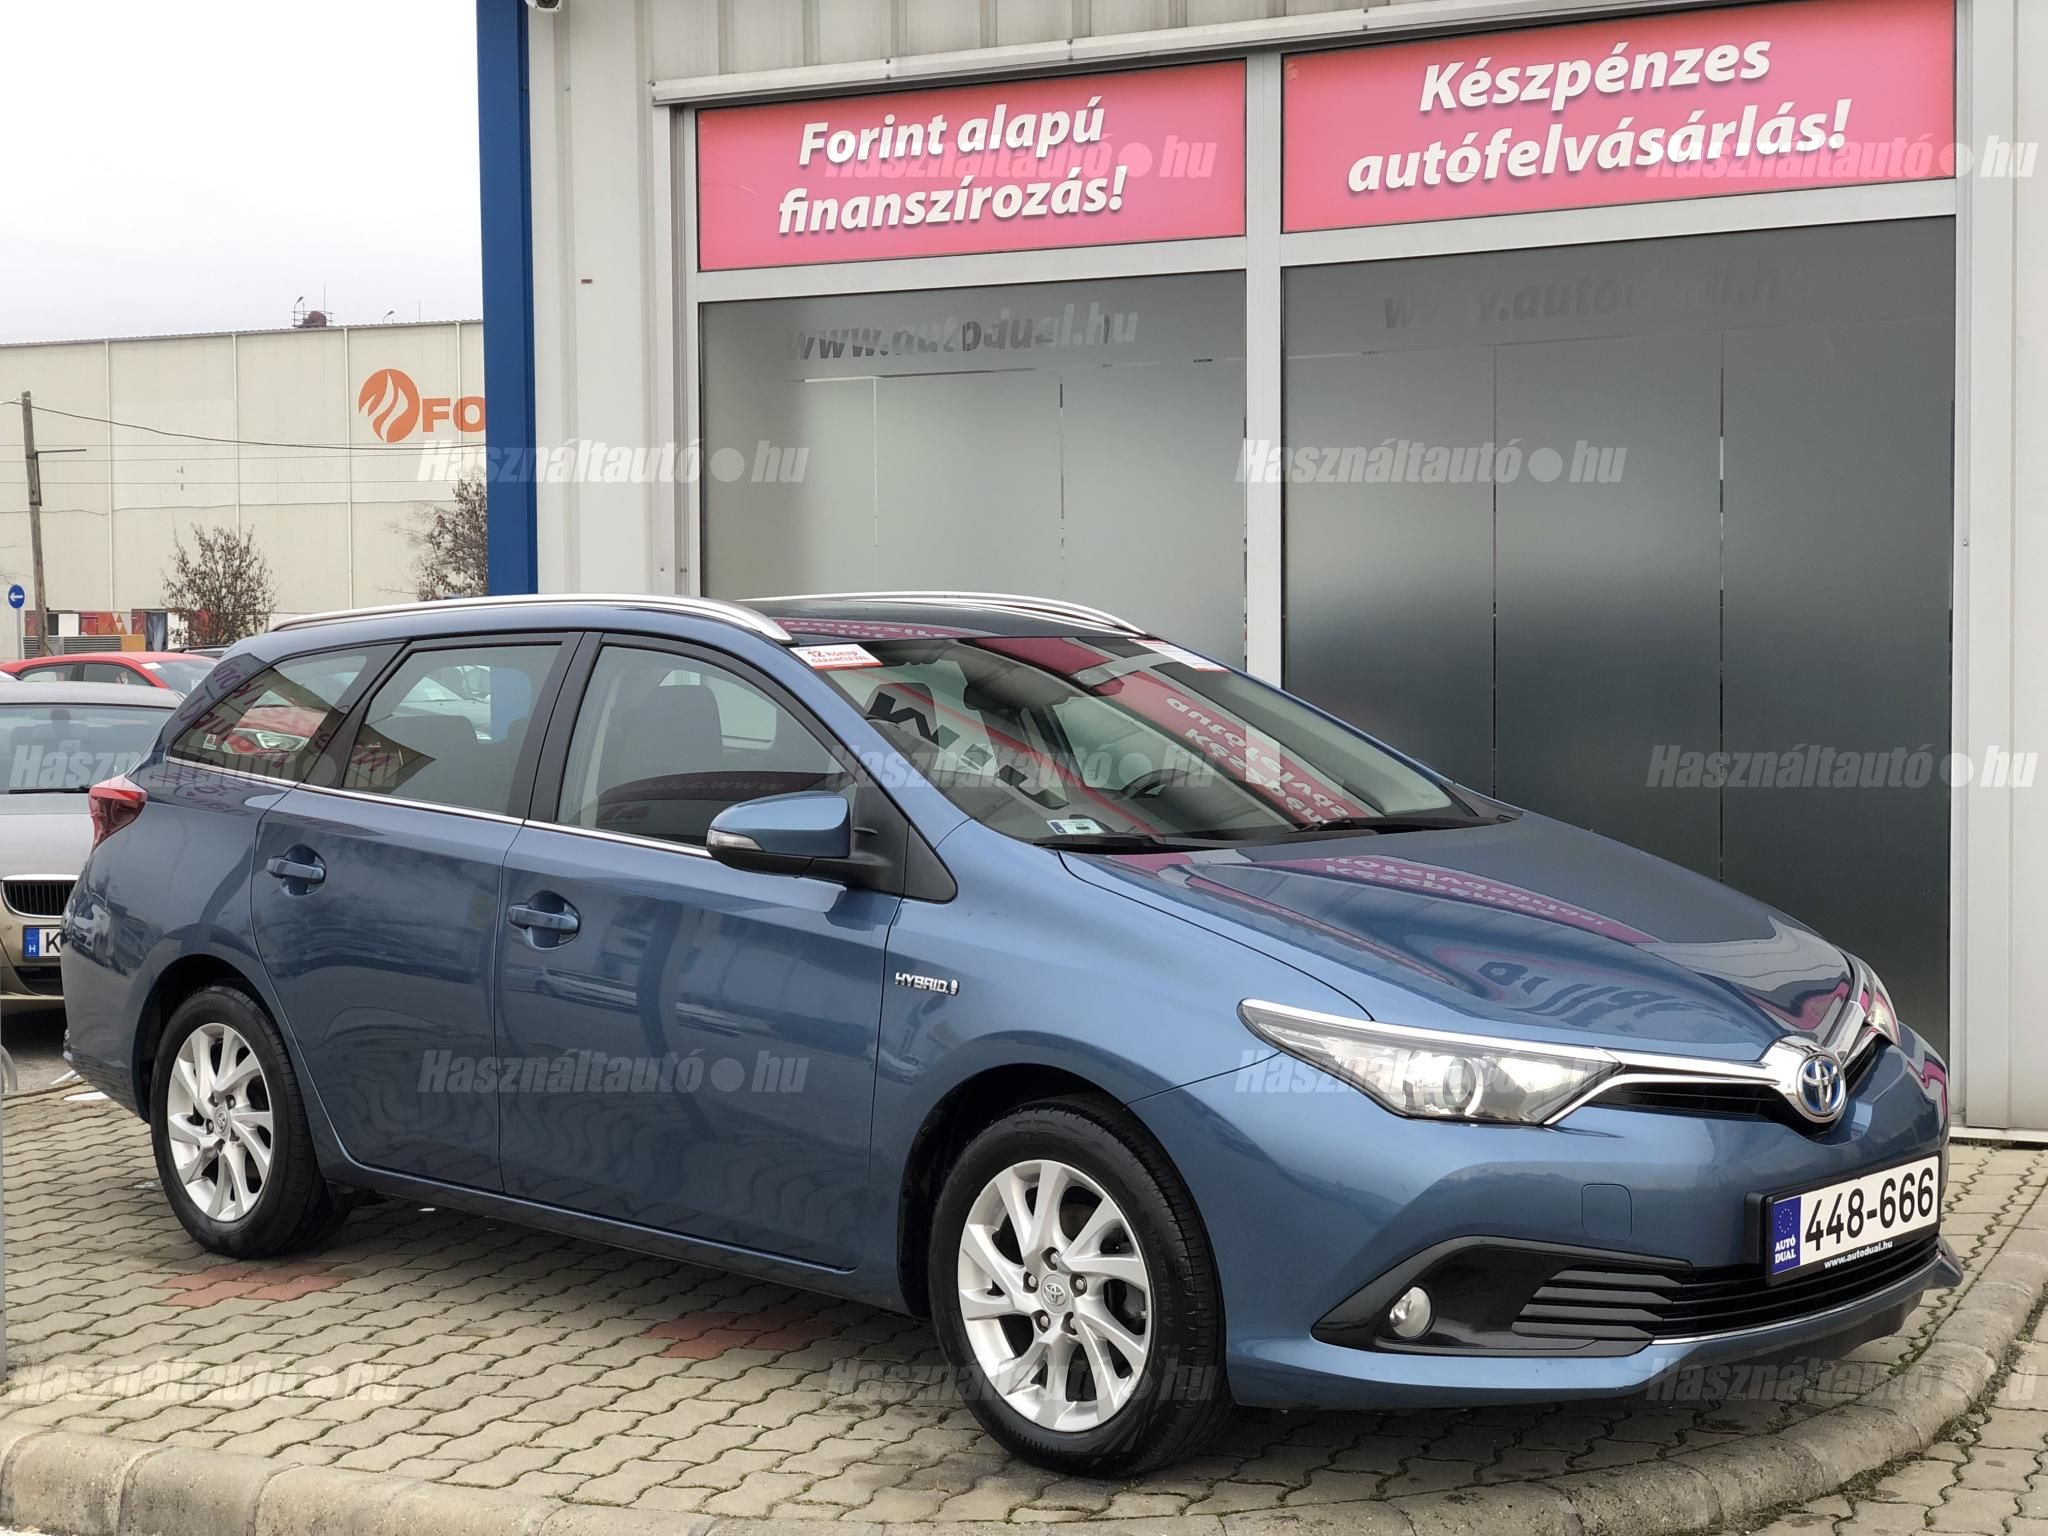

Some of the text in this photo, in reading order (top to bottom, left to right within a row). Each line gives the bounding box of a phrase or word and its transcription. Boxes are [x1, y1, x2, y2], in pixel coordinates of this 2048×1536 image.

[1419, 40, 1772, 112] Készpénzes
[799, 96, 1105, 166] Forint alapú
[1347, 99, 1853, 193] autófelvásárlás!
[778, 165, 1128, 234] finanszírozás!
[894, 971, 948, 994] HYBRID
[1774, 1234, 1797, 1252] AUTÓ
[1805, 1167, 1934, 1251] 448-666
[1774, 1249, 1797, 1264] DUAL
[1824, 1241, 1893, 1269] www.autodual.hu
